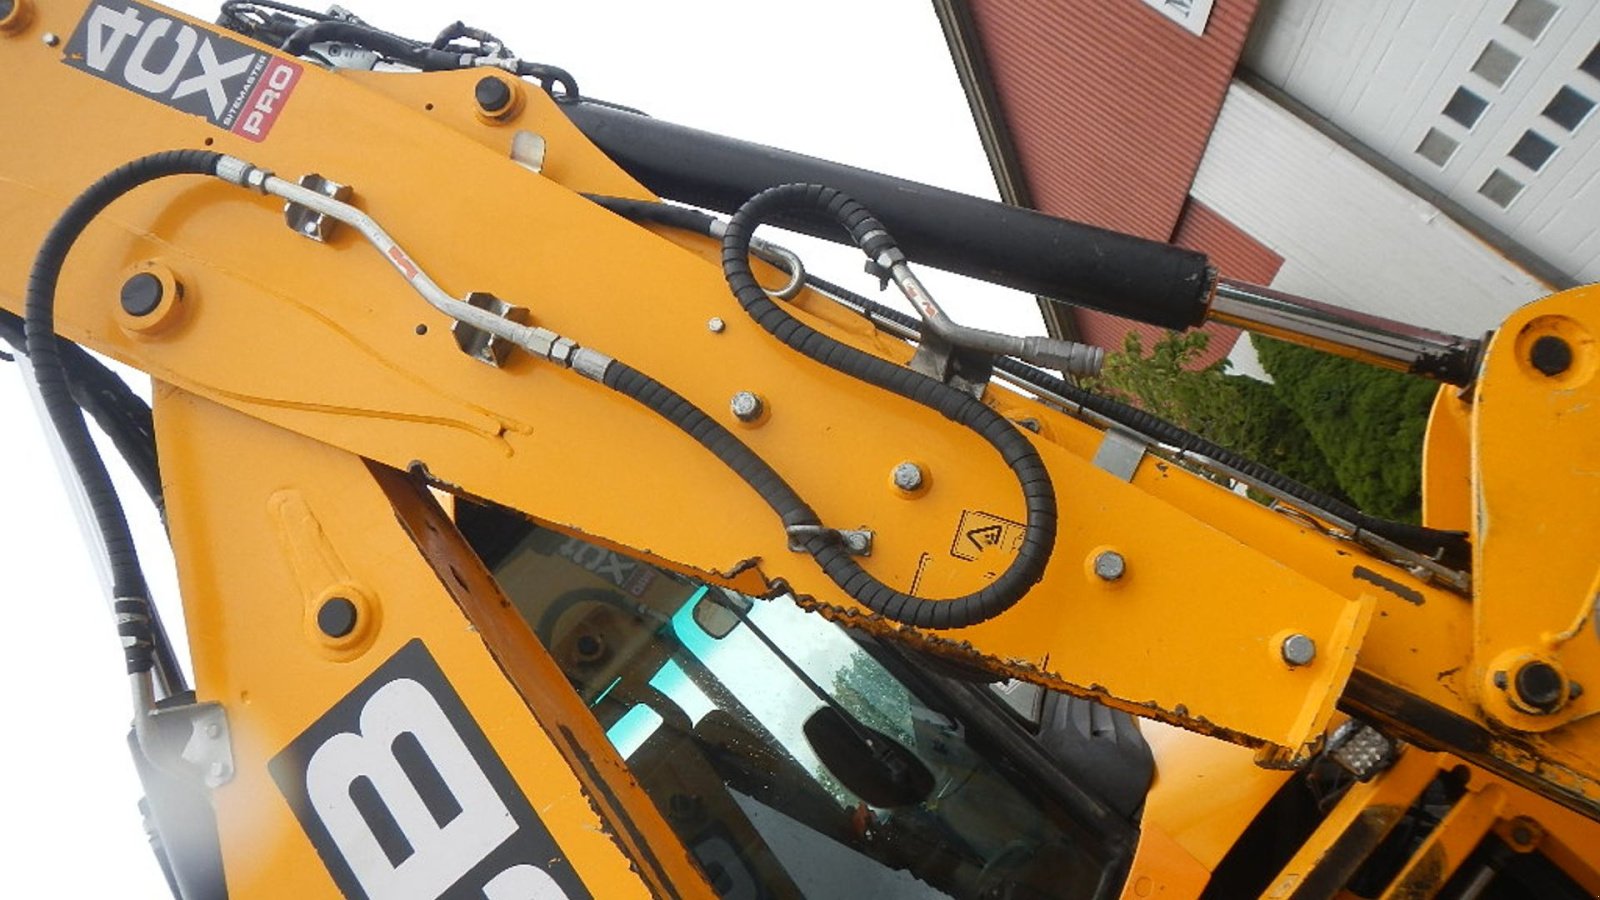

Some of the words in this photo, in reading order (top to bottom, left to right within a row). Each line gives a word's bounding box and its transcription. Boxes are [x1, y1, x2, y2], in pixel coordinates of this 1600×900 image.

[86, 4, 256, 121] 4CX
[222, 54, 268, 127] SITEMASTER
[242, 63, 294, 136] PRO
